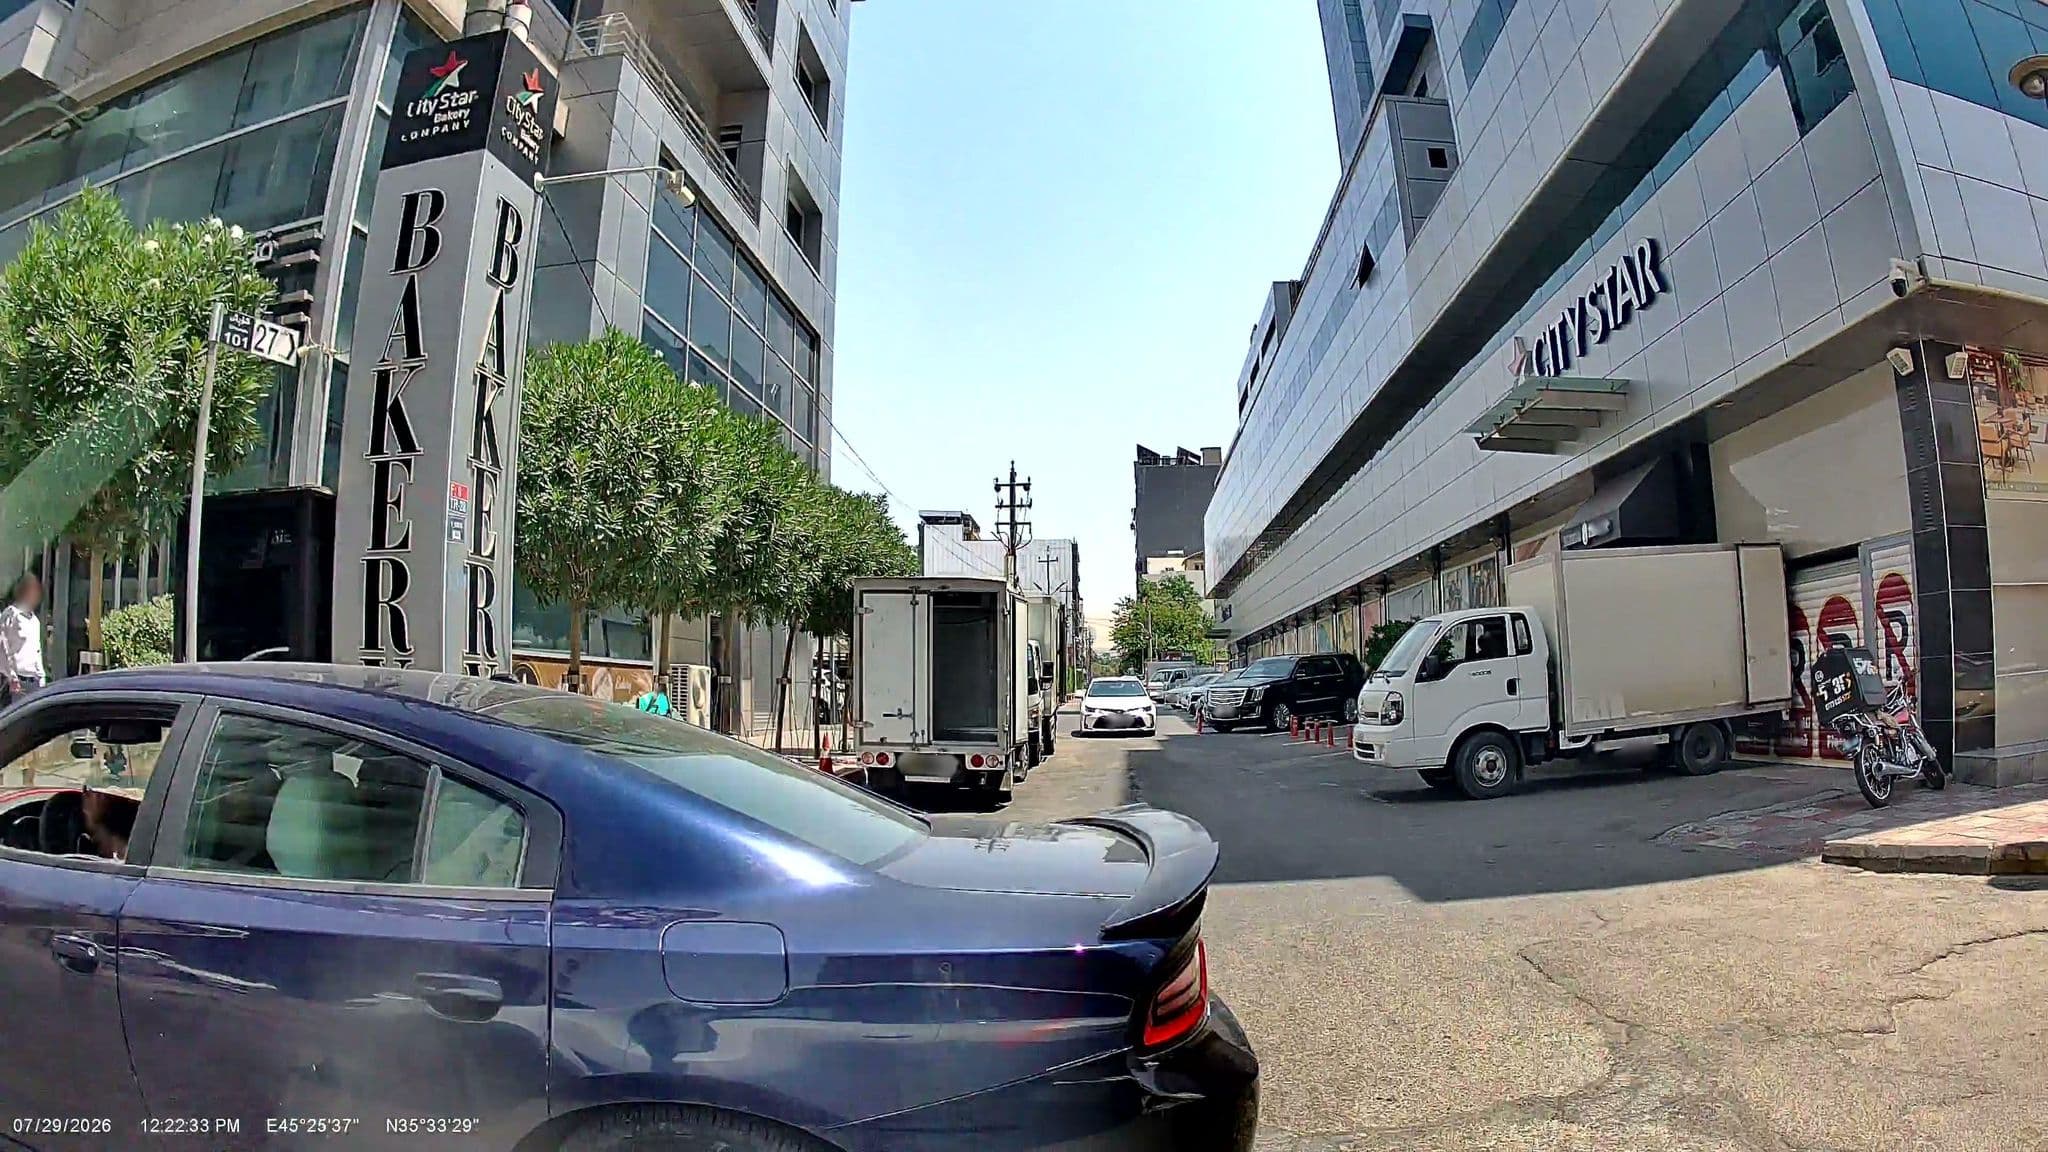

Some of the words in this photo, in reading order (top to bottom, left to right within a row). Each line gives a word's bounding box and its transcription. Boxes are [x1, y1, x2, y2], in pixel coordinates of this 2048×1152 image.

[401, 120, 470, 142] COMPANY
[223, 331, 249, 350] 101
[254, 323, 280, 355] 27
[359, 188, 447, 670] BAKER
[463, 193, 524, 679] BAKER
